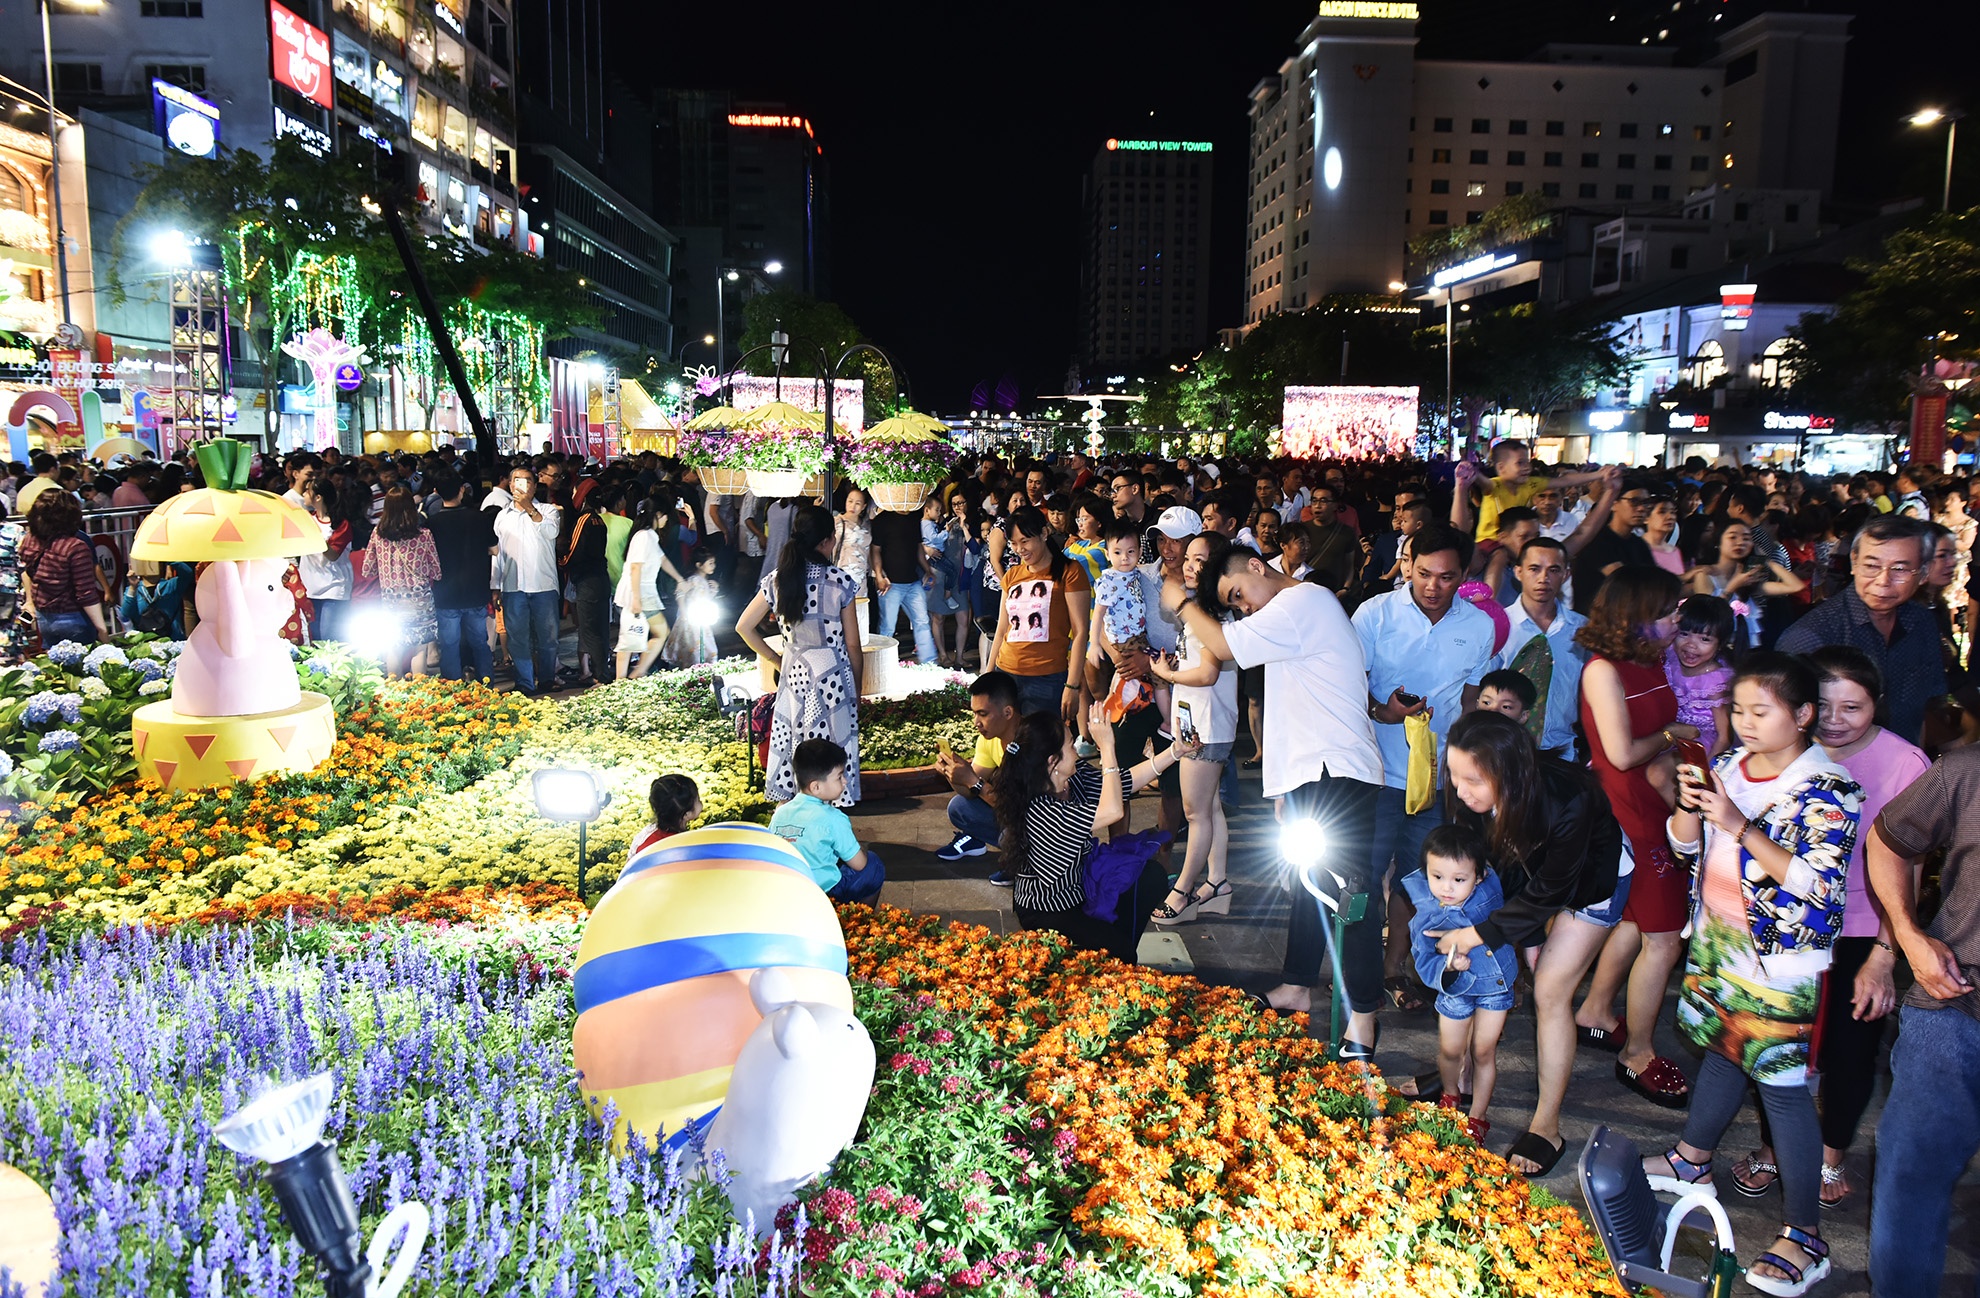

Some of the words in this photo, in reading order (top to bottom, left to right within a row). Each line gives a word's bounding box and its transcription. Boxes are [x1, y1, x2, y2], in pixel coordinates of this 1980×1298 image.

[1319, 0, 1354, 16] SAIGON
[1354, 2, 1388, 18] PRINCE
[1388, 2, 1419, 19] HOTEL
[1117, 140, 1158, 151] HARBOUR
[1159, 141, 1181, 151] VIEW
[1182, 141, 1213, 152] TOWER
[98, 378, 125, 390] 2019
